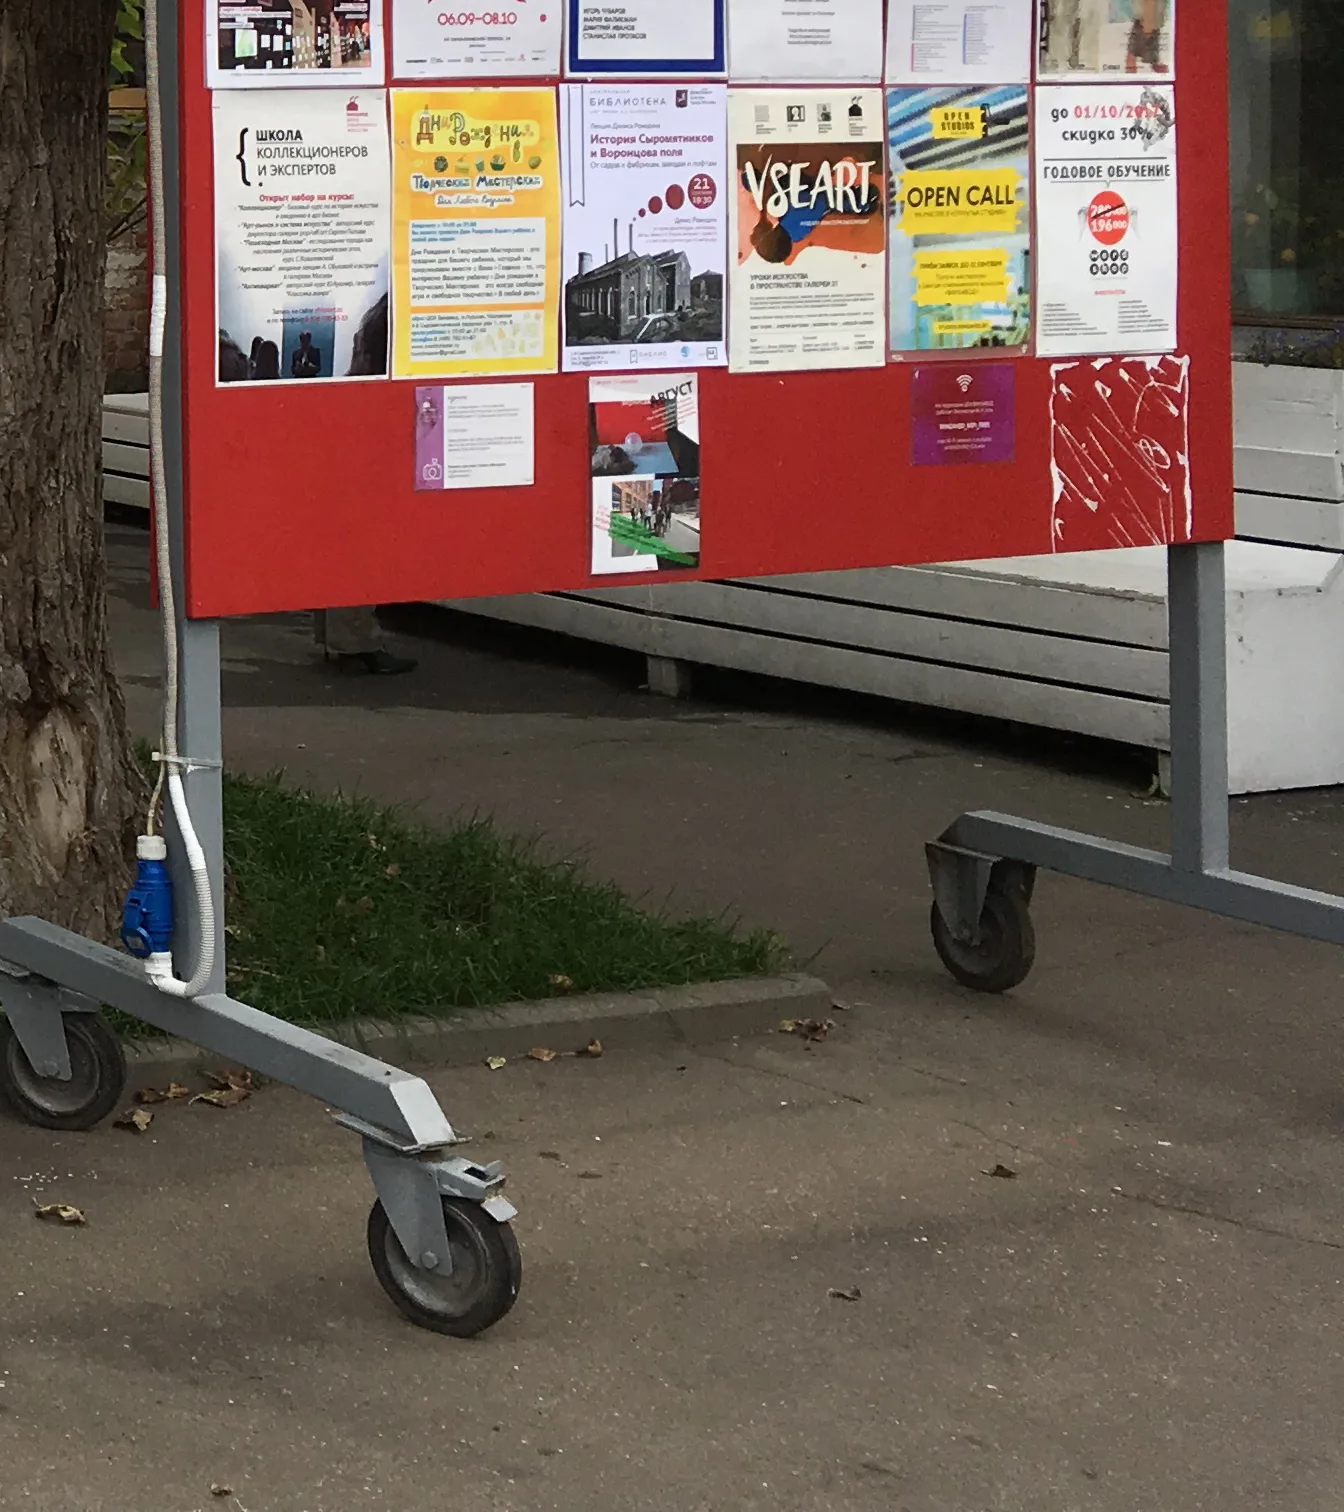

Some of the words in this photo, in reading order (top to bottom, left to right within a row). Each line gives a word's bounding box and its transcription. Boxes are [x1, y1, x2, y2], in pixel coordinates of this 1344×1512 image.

[589, 97, 667, 106] БИБЛИОТЕКА
[944, 112, 970, 120] OPEN
[1051, 108, 1068, 122] до
[941, 122, 975, 131] STUDIOS
[256, 129, 303, 141] ШКОЛА
[590, 134, 636, 146] История
[638, 133, 714, 145] Сыромятников
[1062, 129, 1115, 144] скидка
[1120, 127, 1154, 140] 30%
[257, 146, 368, 160] КОЛЛЕКЦИОНЕРОВ
[600, 148, 658, 159] Воронцова
[660, 149, 683, 157] поля
[257, 165, 267, 176] И
[270, 163, 336, 176] ЭКСПЕРТОВ
[1043, 165, 1103, 179] ГОДОВОЕ
[1108, 164, 1171, 178] ОБУЧЕНИЕ
[693, 178, 710, 190] 21
[745, 153, 876, 218] VSEART
[259, 194, 288, 203] Открыт
[292, 194, 315, 203] набор
[329, 194, 355, 202] курсы:
[907, 186, 960, 207] OPEN
[966, 185, 1014, 206] CALL
[650, 380, 693, 407] АВГУСТ
